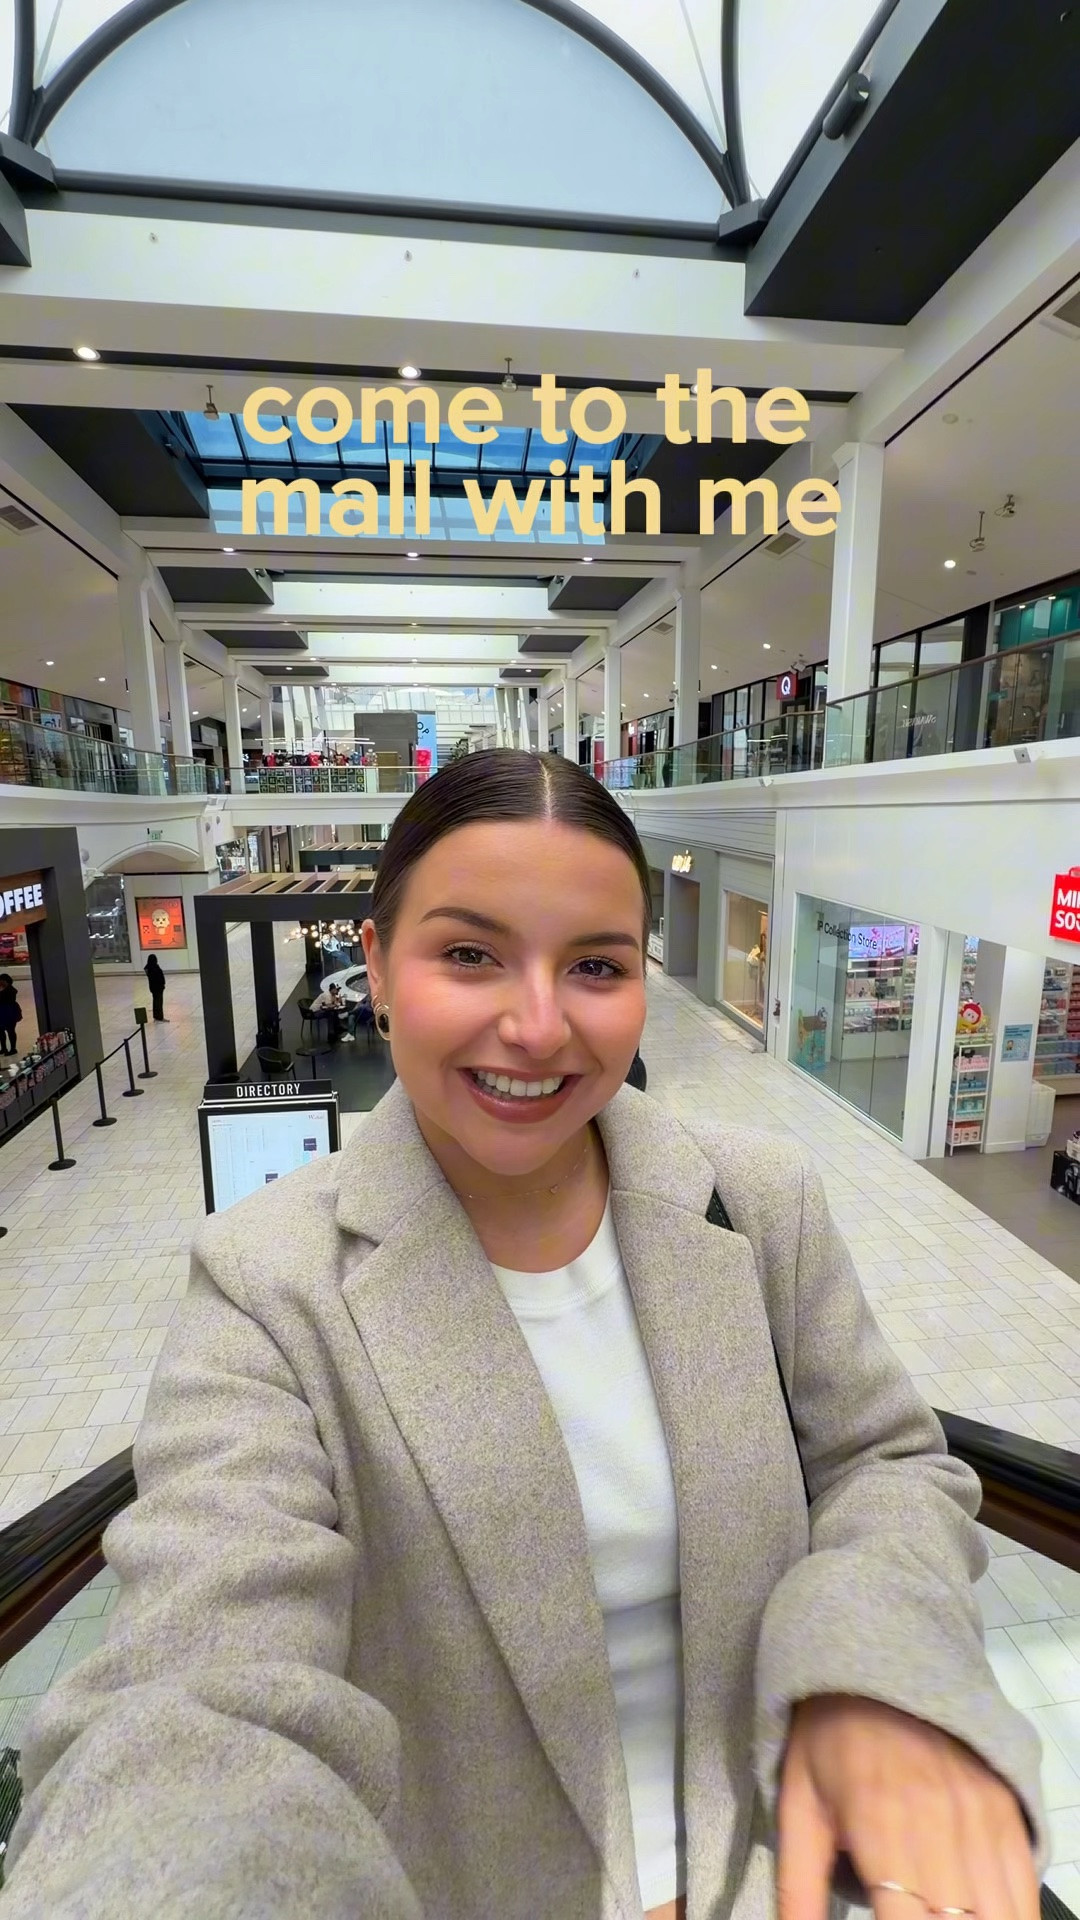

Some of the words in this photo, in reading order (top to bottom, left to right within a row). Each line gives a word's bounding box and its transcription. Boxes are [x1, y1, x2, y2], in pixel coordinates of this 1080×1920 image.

[781, 676, 791, 695] Q
[824, 922, 857, 944] Collection
[858, 932, 877, 950] Store
[236, 1083, 300, 1098] DIRECTORY
